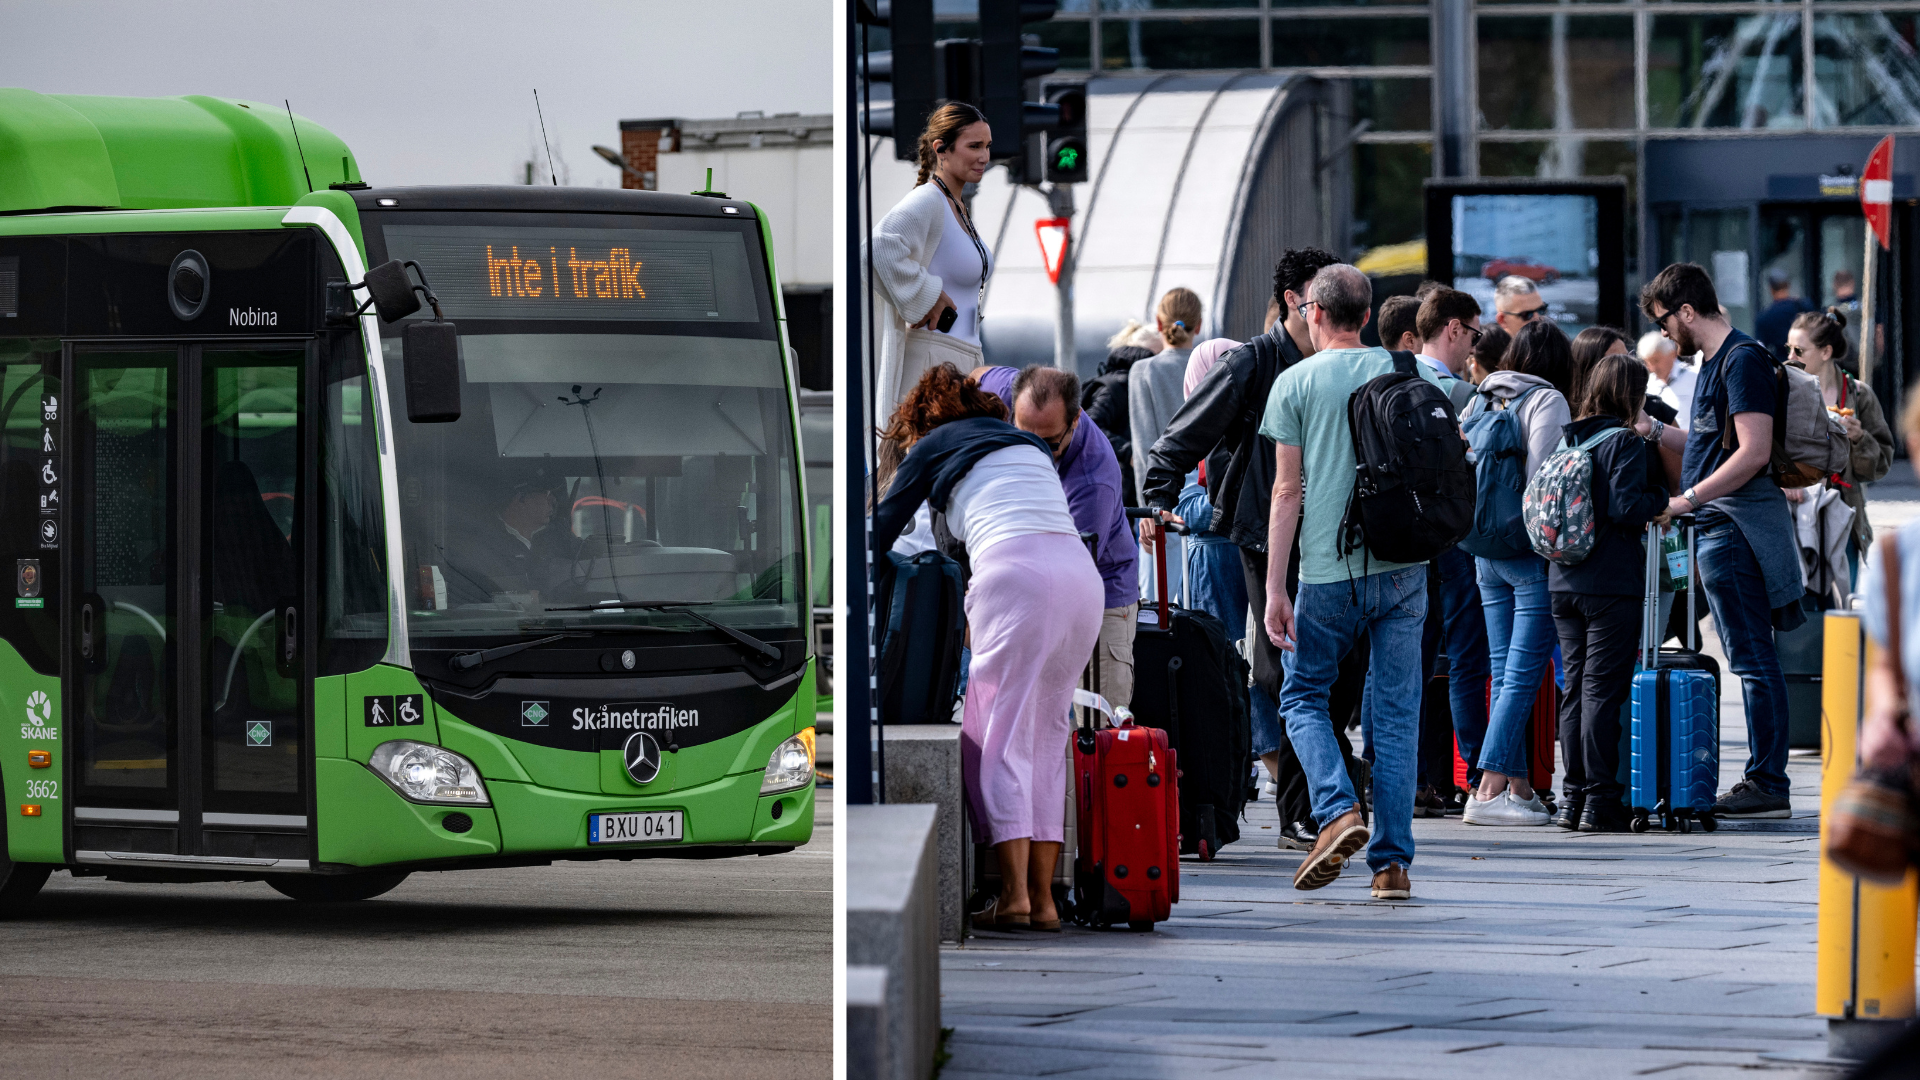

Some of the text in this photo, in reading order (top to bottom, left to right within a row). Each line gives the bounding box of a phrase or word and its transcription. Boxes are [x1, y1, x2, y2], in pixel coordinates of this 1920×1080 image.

[487, 245, 645, 298] Inte i trafik
[229, 306, 277, 326] Nobina
[527, 710, 544, 718] CNG
[572, 704, 699, 730] Skånetrafiken
[26, 780, 58, 799] 3662
[605, 815, 674, 838] BXU 041
